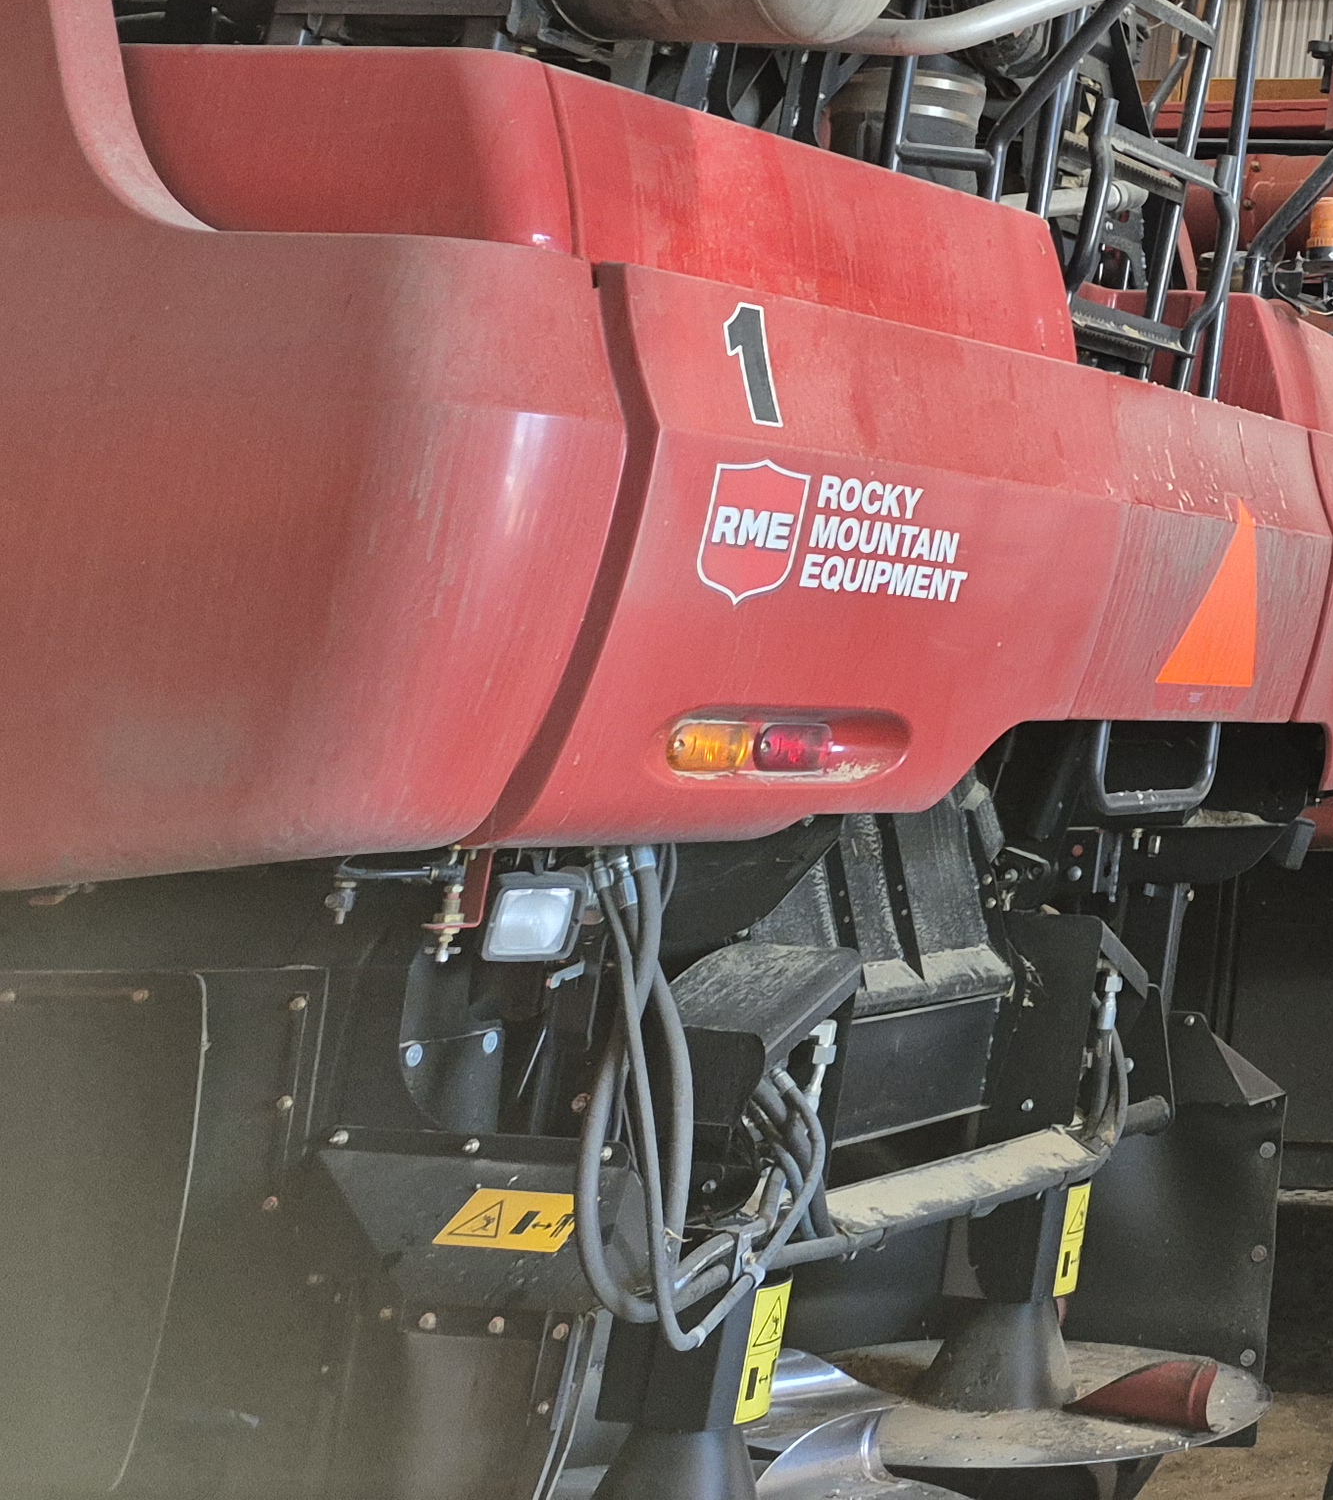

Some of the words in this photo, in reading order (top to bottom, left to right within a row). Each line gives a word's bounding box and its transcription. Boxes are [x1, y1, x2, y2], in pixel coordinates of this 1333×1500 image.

[723, 302, 783, 427] 1
[817, 474, 924, 519] ROCKY
[711, 506, 795, 551] RME
[808, 514, 960, 563] MOUNTAIN
[799, 553, 968, 603] EQUIPMENT
